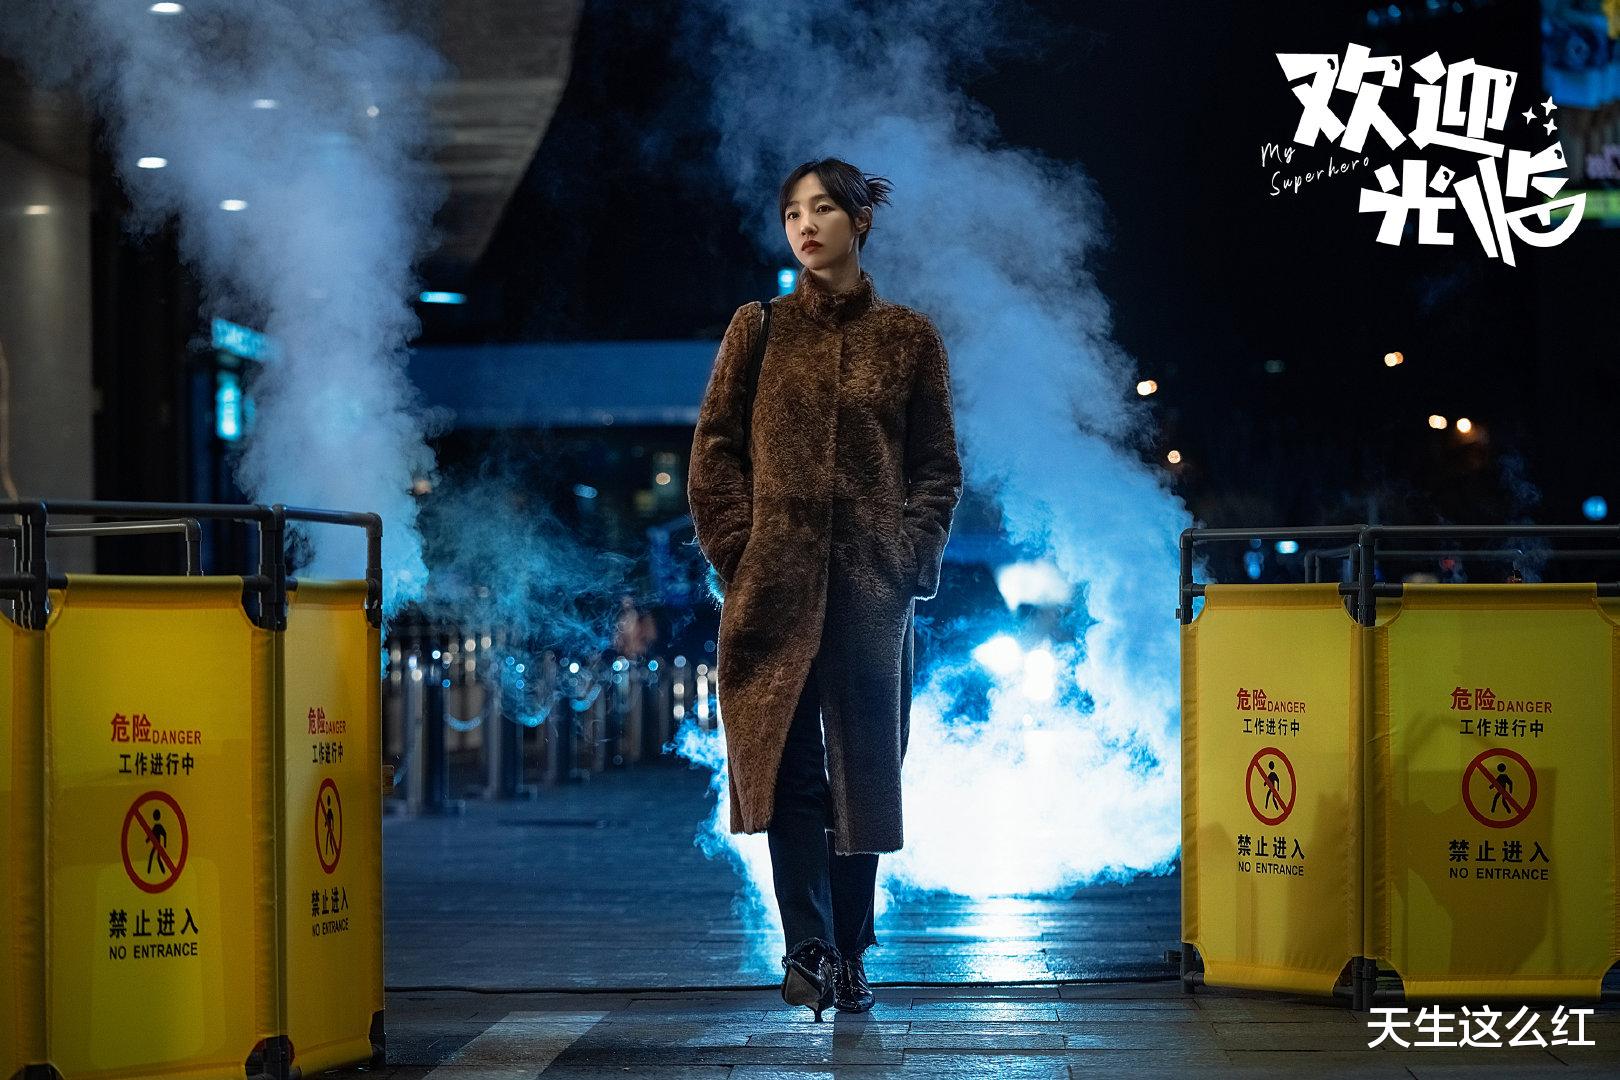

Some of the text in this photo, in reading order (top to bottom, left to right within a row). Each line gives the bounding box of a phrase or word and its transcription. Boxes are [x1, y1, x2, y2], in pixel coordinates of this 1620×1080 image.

[1236, 687, 1306, 714] 危险 DANGER
[1450, 686, 1552, 713] 危险 DANGER
[111, 713, 201, 745] 危险 DANGER
[308, 707, 347, 734] 危险 DANGER
[1243, 718, 1300, 738] 工作进行中
[1460, 718, 1544, 738] 工作进行中
[118, 752, 195, 776] 工作进行中
[312, 742, 344, 764] 工作进行中
[1237, 834, 1305, 860] 禁止进入
[1448, 839, 1550, 863] 禁止进入
[1238, 861, 1304, 876] NO ENTRANCE
[1449, 867, 1549, 881] NO ENTRANCE
[311, 886, 349, 917] 禁止进入
[108, 908, 199, 938] 禁止进入
[312, 917, 349, 936] NO ENTRANCE
[109, 942, 198, 960] NO ENTRANCE
